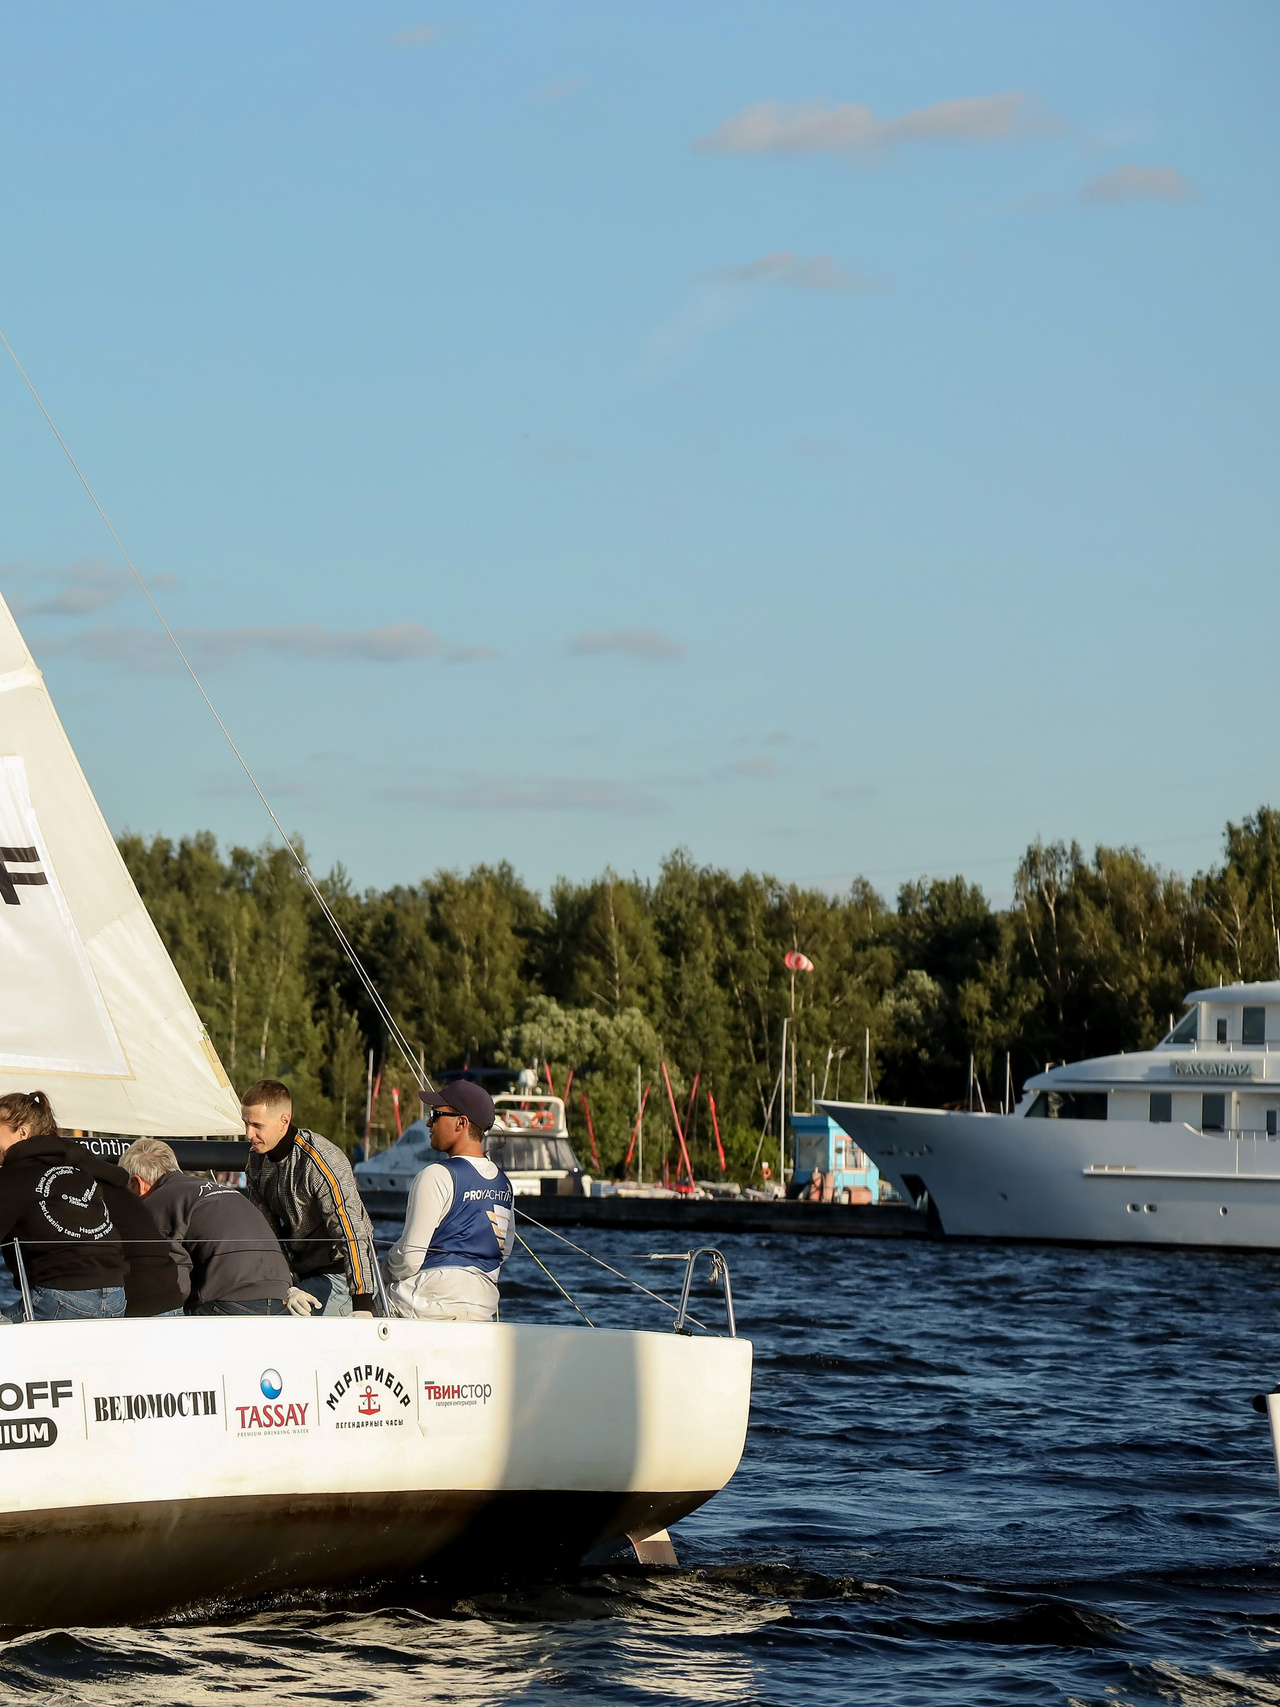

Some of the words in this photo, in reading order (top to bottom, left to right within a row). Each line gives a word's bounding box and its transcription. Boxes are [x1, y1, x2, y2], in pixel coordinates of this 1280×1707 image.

[64, 1228, 81, 1238] team
[325, 1364, 412, 1412] МОРПРИБОР
[93, 1390, 218, 1424] ВЕДОМОСТИ
[235, 1402, 310, 1429] TASSAY
[263, 1429, 291, 1437] DRINKING
[335, 1420, 384, 1430] ЛЕГЕНДАРНЫЕ
[385, 1418, 404, 1427] ЧАСЫ
